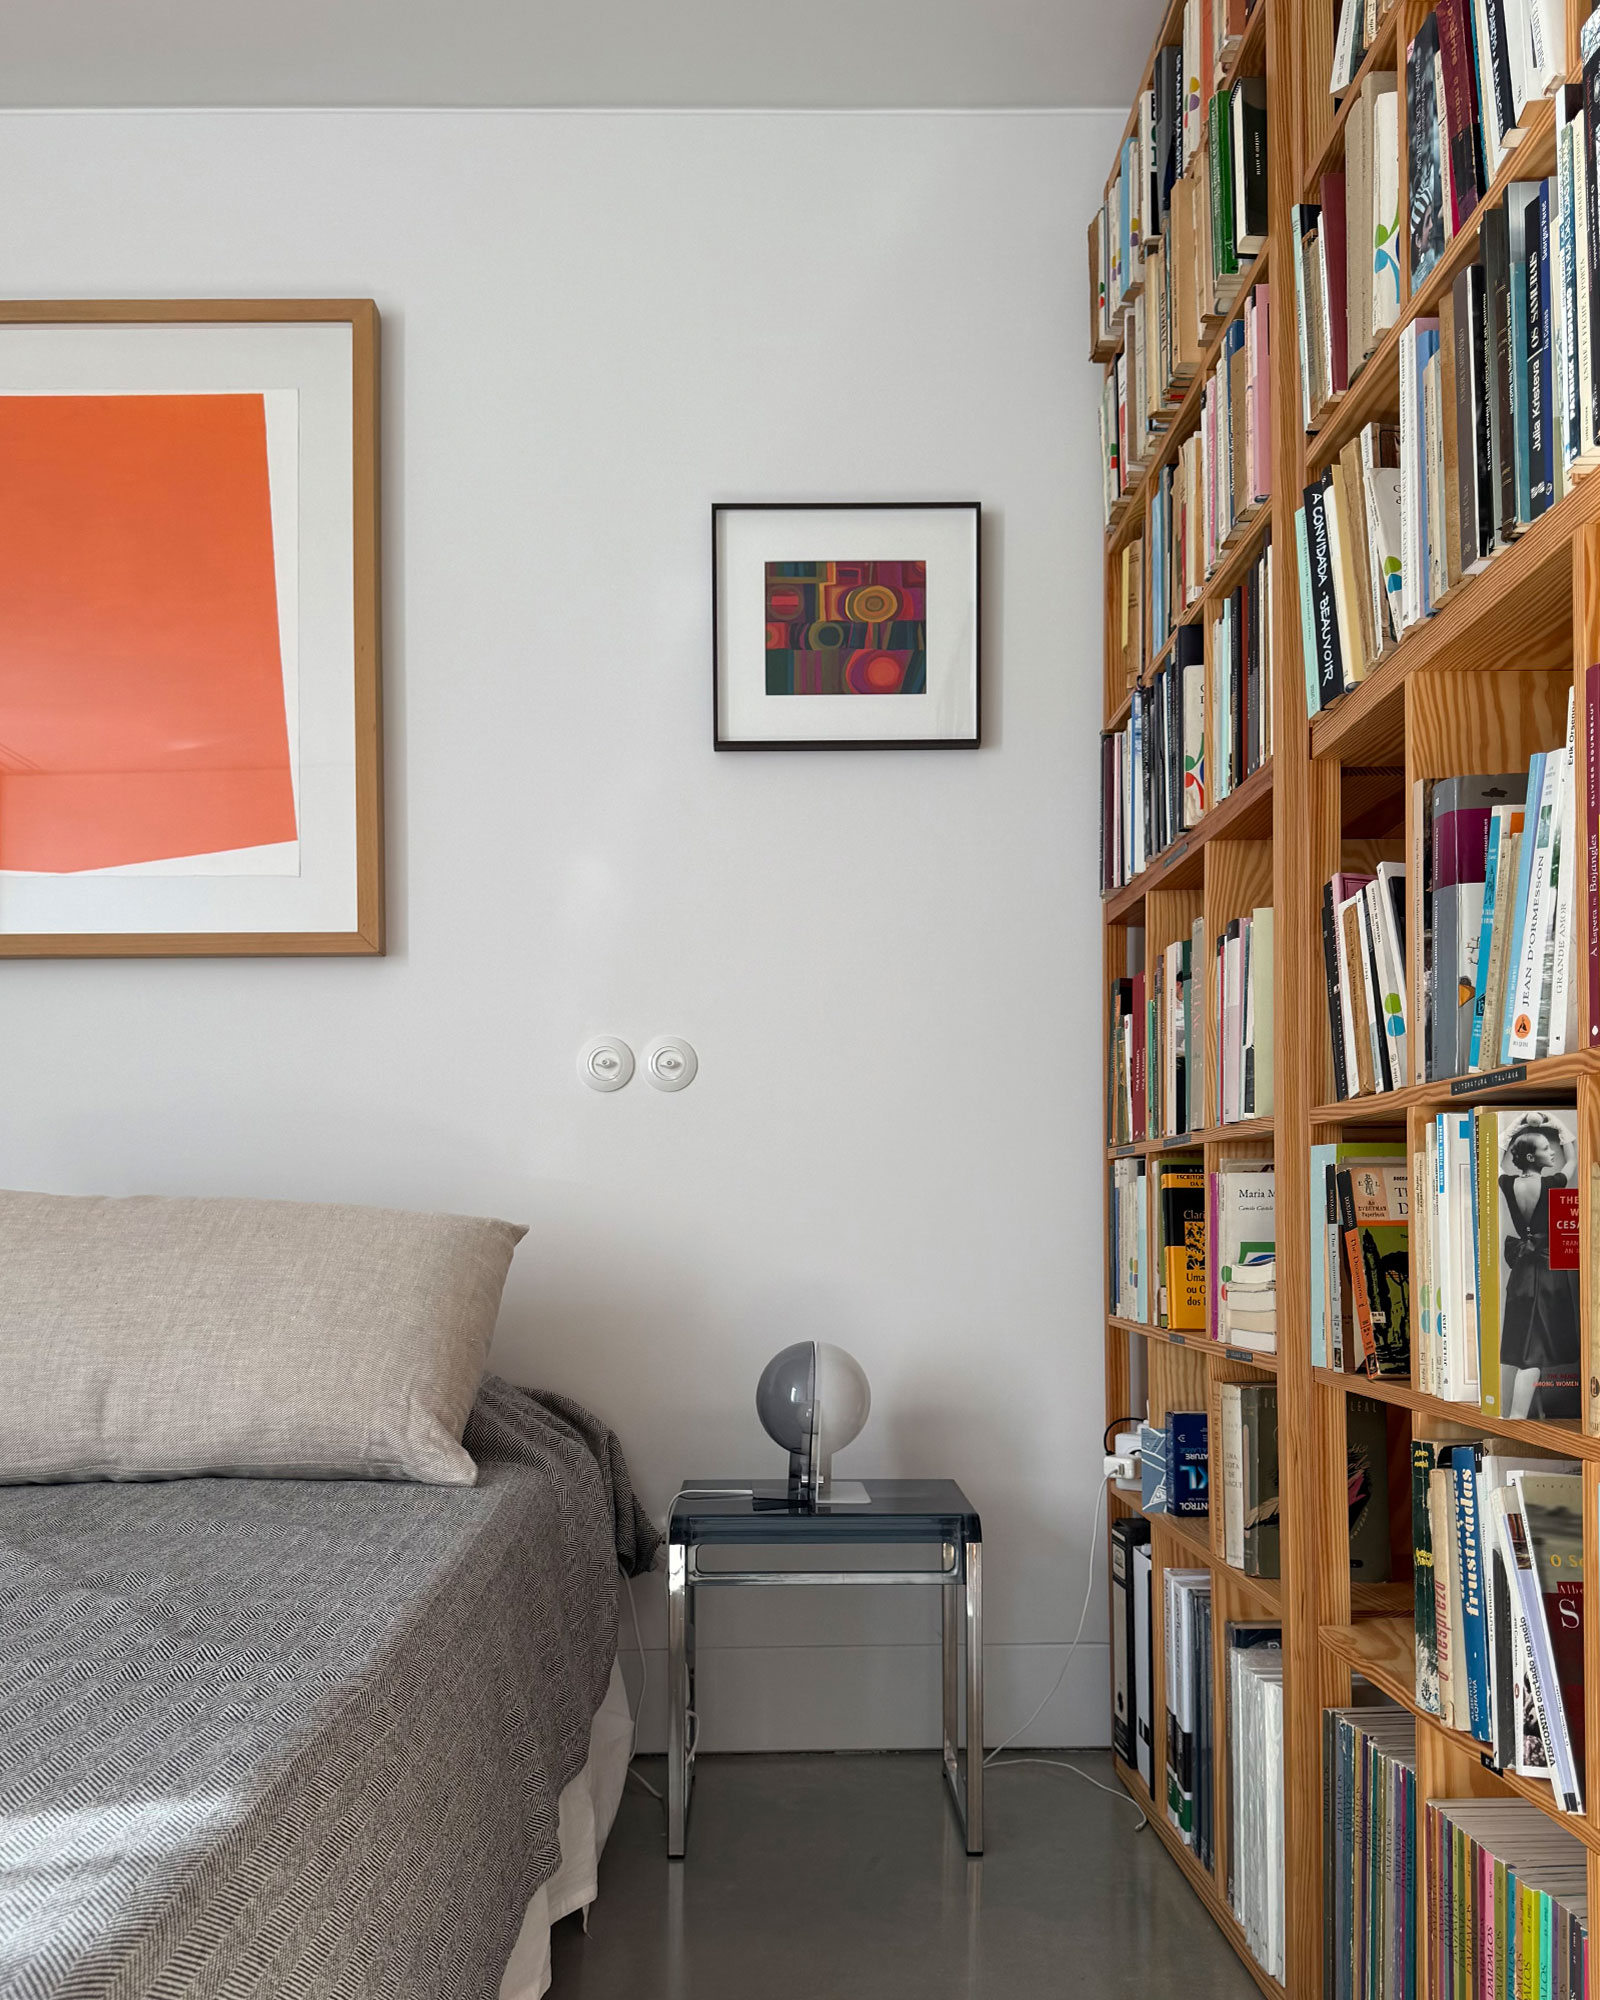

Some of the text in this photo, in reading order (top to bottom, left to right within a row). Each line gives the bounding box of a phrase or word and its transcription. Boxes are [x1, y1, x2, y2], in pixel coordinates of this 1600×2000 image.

[1540, 201, 1549, 261] Georges Perec
[1528, 252, 1540, 348] OS SAMURAIS
[1578, 259, 1587, 291] PORTA
[1580, 306, 1588, 337] FECHE
[1566, 287, 1576, 421] PATRICK MODIANO
[1581, 347, 1589, 381] ENTRE
[1531, 359, 1541, 452] Julia Kristeva
[1312, 494, 1328, 587] A CONVIDADA
[1319, 597, 1334, 686] BEAUVOIR
[1589, 833, 1599, 892] Bojangles
[1522, 854, 1545, 1007] JEAN D'ORMESSON
[1556, 902, 1567, 994] GRANDE AMOR
[1454, 1071, 1519, 1092] LITERATURA ITALIANA
[1238, 1189, 1265, 1198] Maria
[1559, 1196, 1580, 1205] THE
[1186, 1273, 1205, 1282] Uma
[1186, 1286, 1197, 1294] ou
[1186, 1298, 1201, 1306] dos
[1460, 1469, 1480, 1617] frustradas
[1550, 1553, 1562, 1567] O
[1519, 1616, 1556, 1767] VISCONDE cortado ao meio
[1486, 1924, 1494, 1999] DAIDALOS
